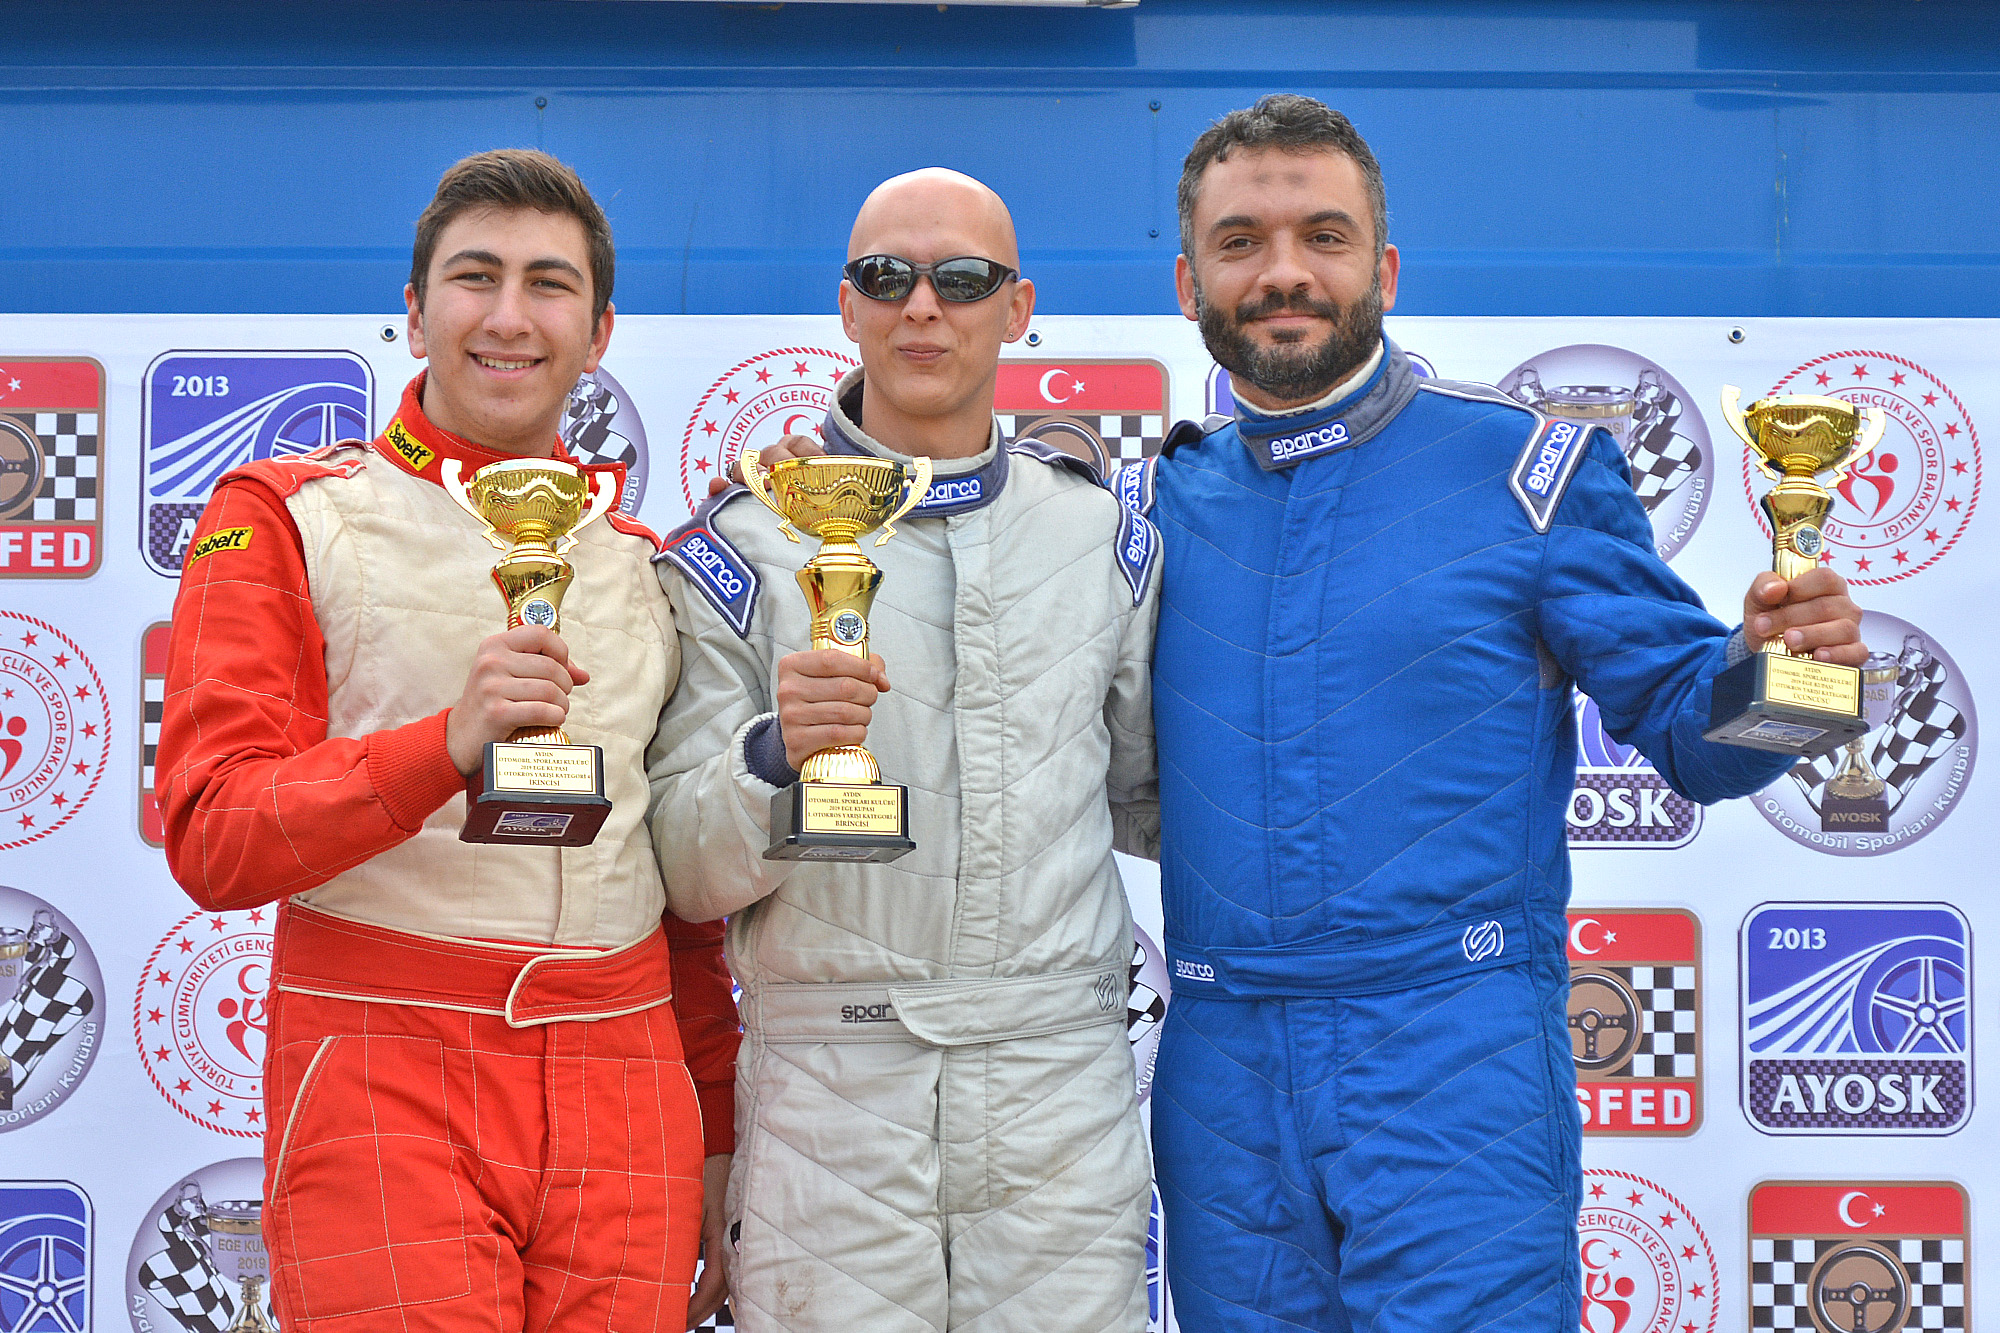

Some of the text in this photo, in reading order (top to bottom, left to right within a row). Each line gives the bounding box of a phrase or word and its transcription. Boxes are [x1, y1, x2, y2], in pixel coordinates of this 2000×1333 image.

[171, 375, 230, 397] 2013
[780, 390, 831, 407] GENÇL
[1271, 424, 1348, 460] sparco
[1528, 422, 1576, 493] sparco
[1840, 393, 1938, 538] GENÇLİK VE SPOR BAKANLIĞI
[914, 479, 981, 507] parco
[1669, 477, 1707, 543] Kulübü
[0, 531, 91, 567] FED
[683, 537, 743, 599] sparco
[0, 655, 67, 803] ÇLİK VE SPOR BAKANLIĞI
[1565, 787, 1675, 828] OSK
[1764, 745, 1970, 852] Otomobil Sporları Kulübü
[1829, 812, 1882, 823] AYOSK
[1768, 927, 1827, 950] 2013
[1176, 959, 1215, 981] sparco
[178, 943, 231, 1038] CUMHURİYETİ
[58, 1021, 97, 1090] Kulübü
[183, 1040, 235, 1091] TÜRKİYE
[1771, 1074, 1946, 1114] AYOSK
[218, 1239, 242, 1251] EGE
[237, 1257, 267, 1269] 2019
[1578, 1213, 1642, 1237] GENÇLİK
[1642, 1232, 1660, 1252] VE
[1655, 1252, 1675, 1292] SPOR
